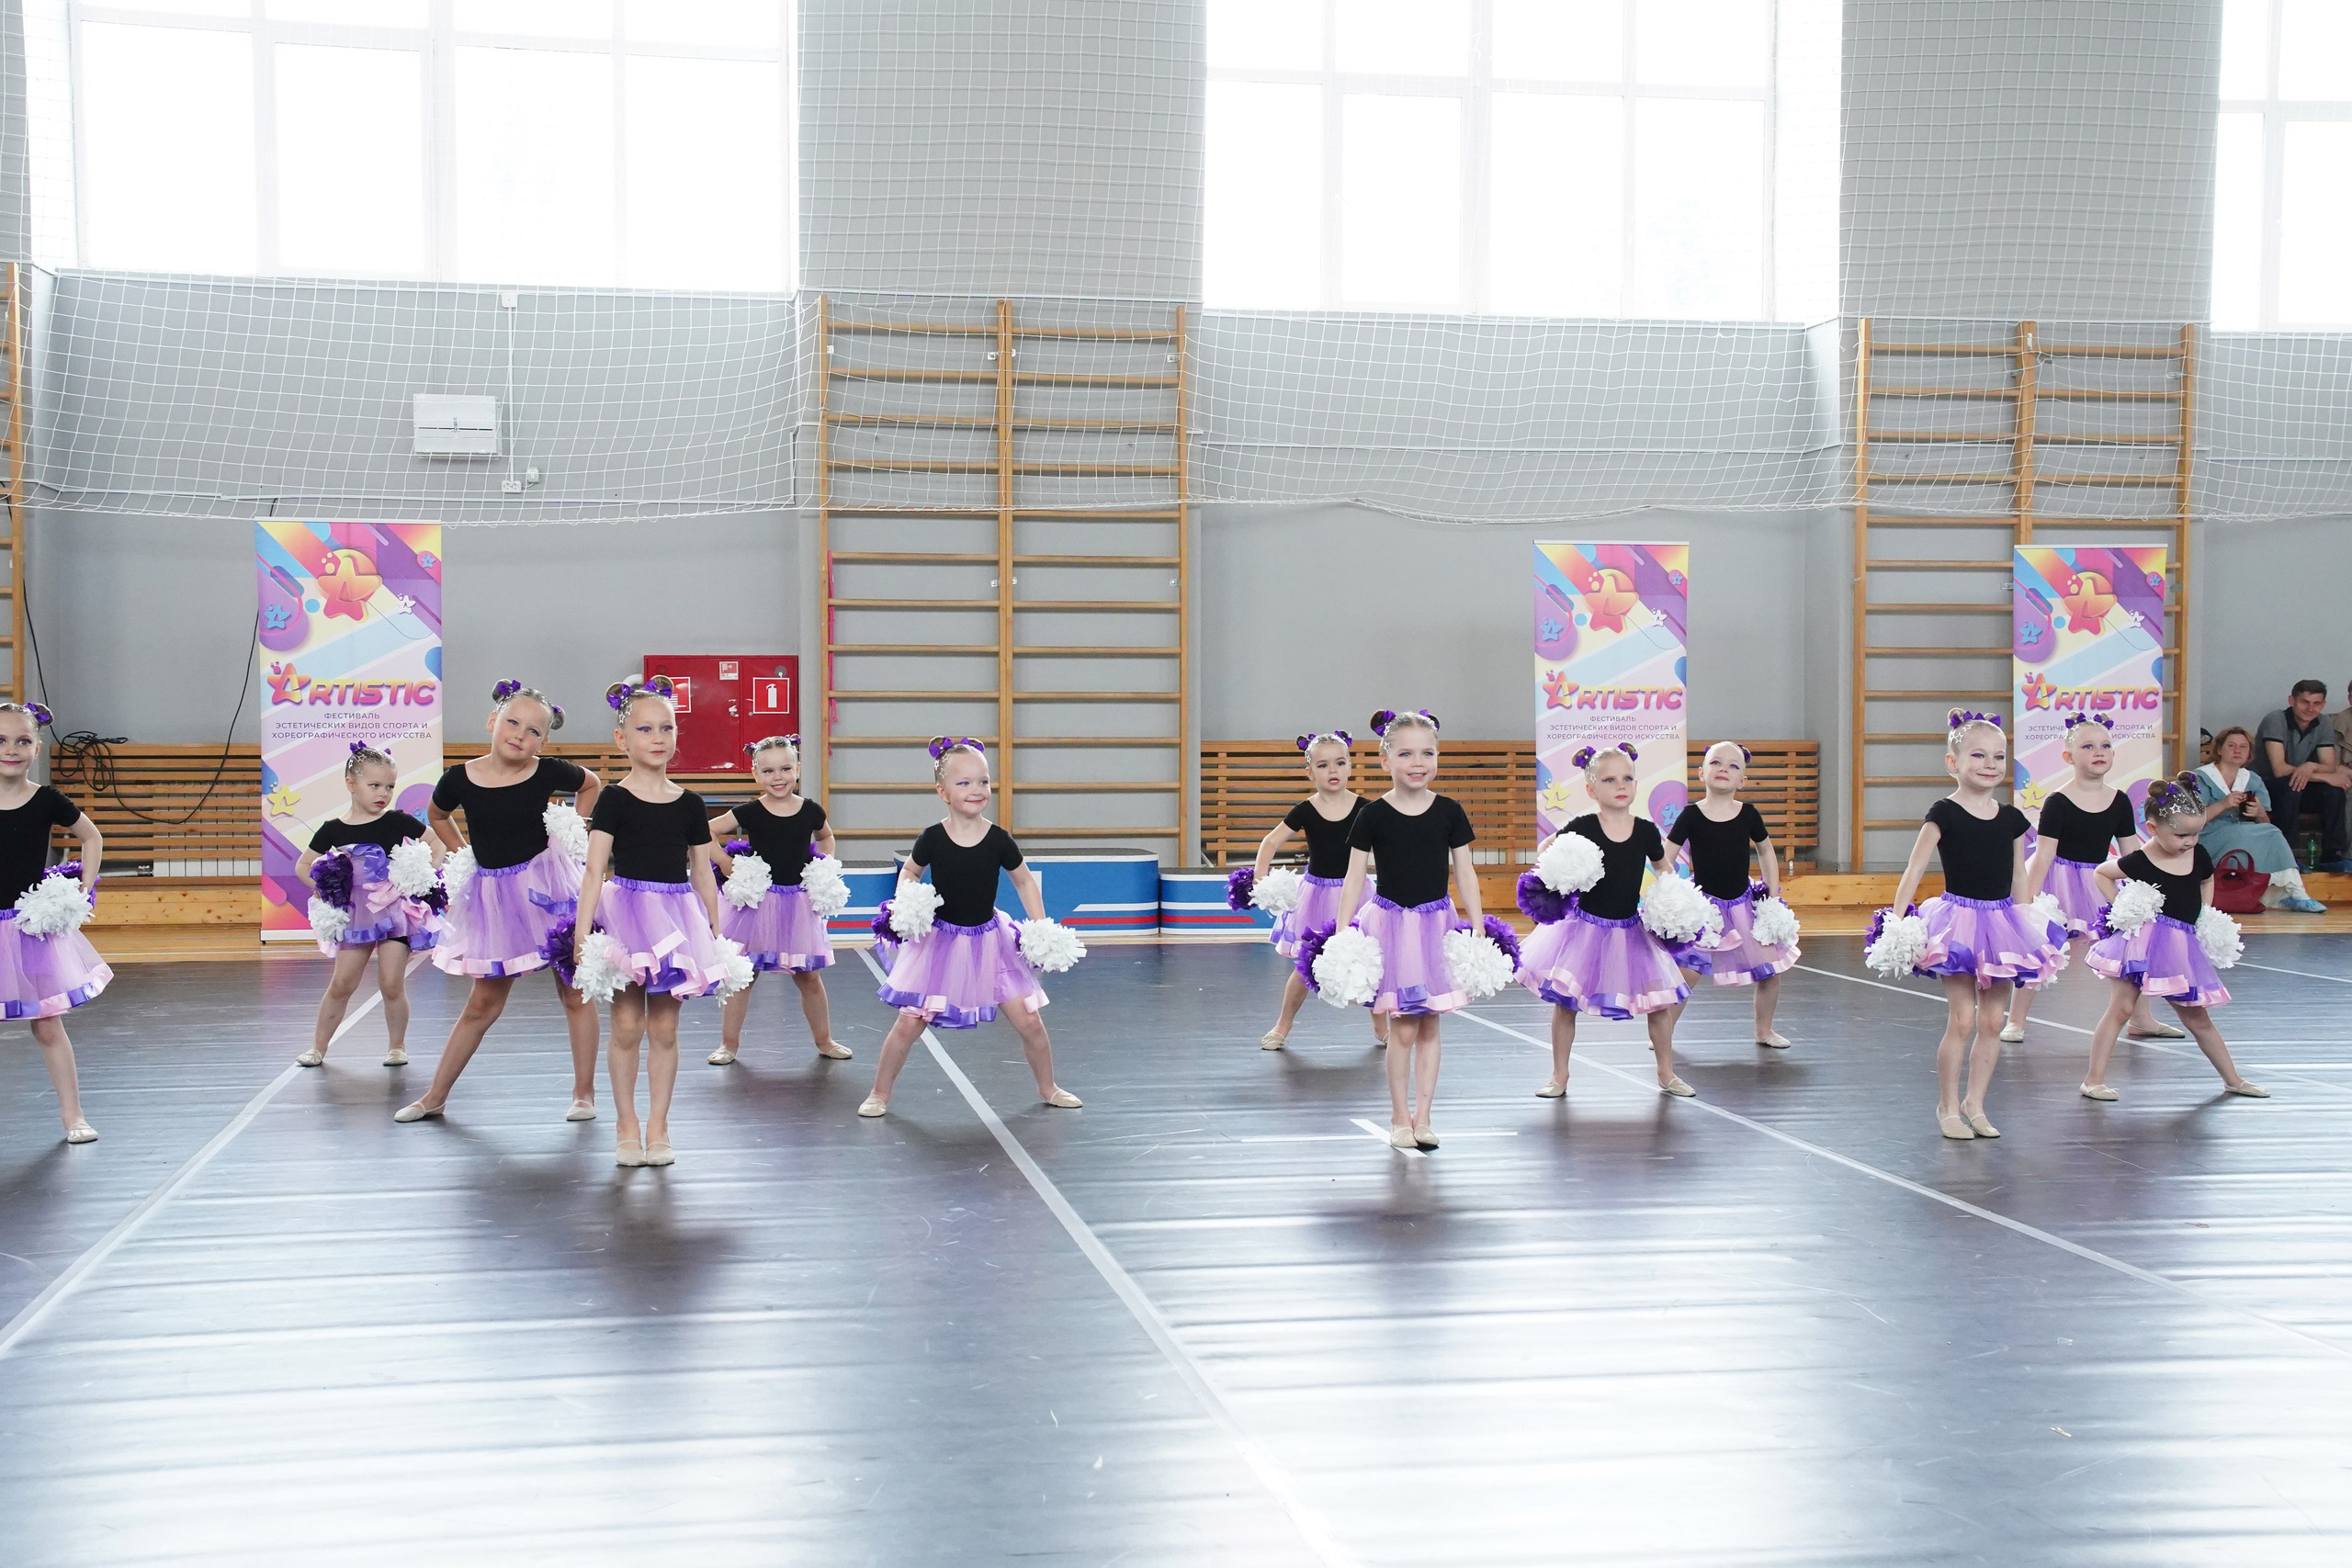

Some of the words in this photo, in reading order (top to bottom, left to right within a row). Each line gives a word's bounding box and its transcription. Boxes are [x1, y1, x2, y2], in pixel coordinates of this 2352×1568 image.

[266, 662, 436, 706] ARTISTIC
[1543, 671, 1683, 710] ARTISTIC
[2021, 672, 2159, 711] ARTISTIC
[271, 731, 377, 739] ХОРЕОГРАФИЧЕСКОГО
[348, 722, 380, 730] ВИДОВ
